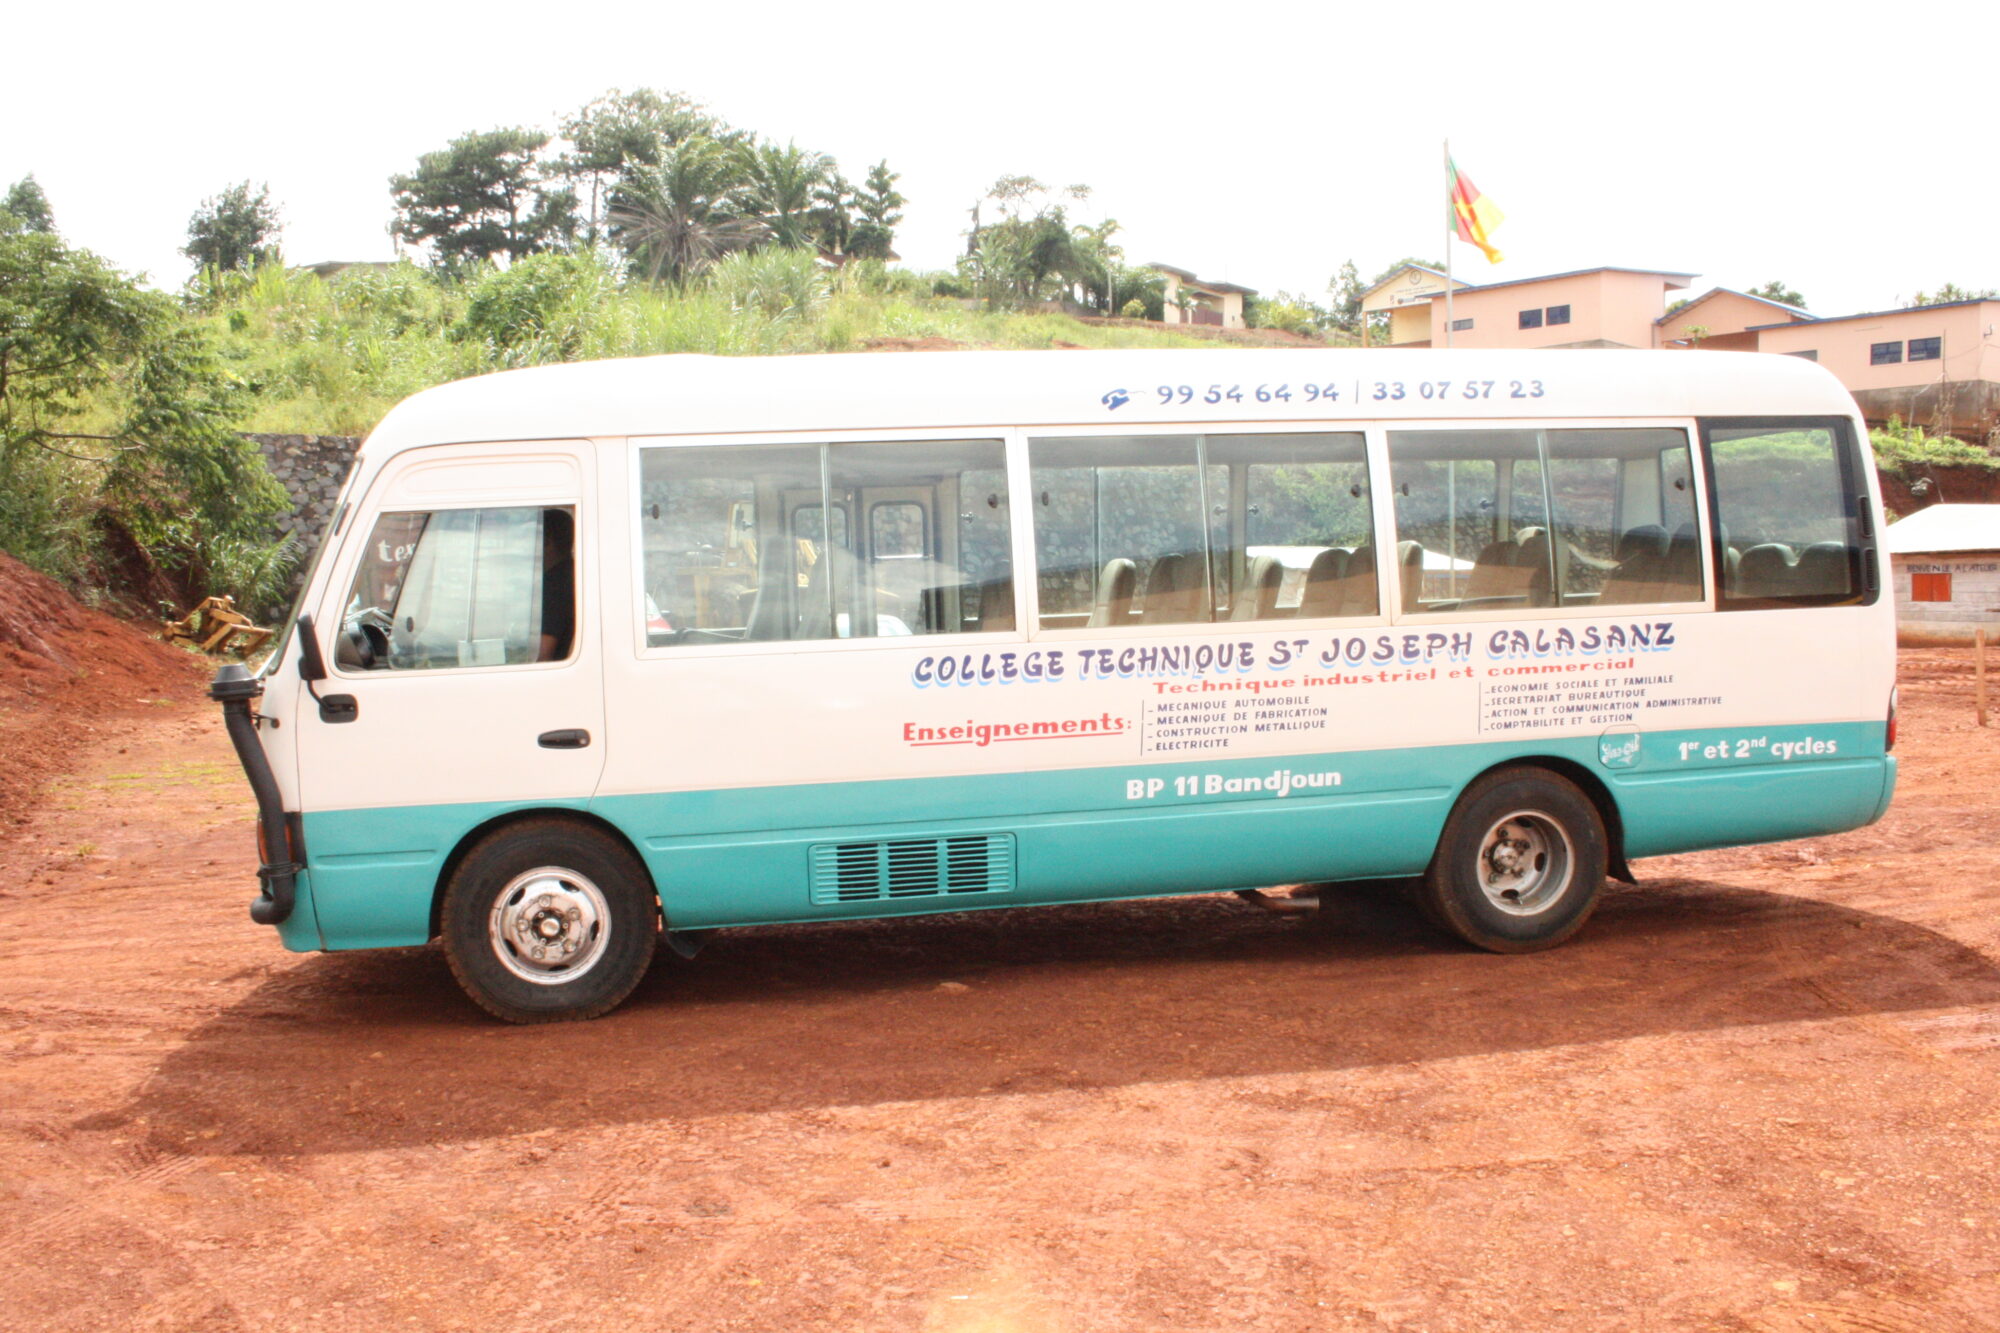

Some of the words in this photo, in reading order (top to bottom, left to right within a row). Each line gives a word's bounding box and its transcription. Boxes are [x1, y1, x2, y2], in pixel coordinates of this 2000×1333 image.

[1157, 385, 1194, 405] 99
[1204, 384, 1244, 404] 54
[1255, 384, 1292, 403] 64
[1304, 382, 1339, 402] 94
[1373, 382, 1406, 401] 33
[1419, 381, 1451, 400] 07
[1462, 380, 1495, 399] 57
[1510, 380, 1545, 399] 23
[913, 650, 1066, 688] COLLEGE
[1078, 642, 1255, 680] TECHNIQUE
[1319, 632, 1473, 668] JOSEPH
[1486, 623, 1676, 659] CALASANZ
[1153, 678, 1296, 695] Technique
[1303, 668, 1436, 687] industriel
[1449, 666, 1475, 679] et
[1487, 658, 1635, 677] commercial
[1491, 683, 1549, 694] ECONOMIE
[1556, 680, 1600, 690] SOCIALE
[1605, 678, 1618, 688] ET
[1624, 675, 1674, 686] FAMILIALE
[1157, 700, 1228, 712] MECANIQUE
[1234, 696, 1311, 708] AUTOMOBILE
[1491, 694, 1562, 706] SECRETARIAT
[1569, 689, 1646, 702] BUREAUTIQUE
[1491, 708, 1528, 718] ACTION
[1534, 707, 1545, 716] ET
[1552, 701, 1640, 714] COMMUNICATION
[1646, 696, 1723, 709] ADMINISTRATIVE
[1157, 713, 1227, 726] MECANIQUE
[1233, 712, 1248, 721] DE
[1255, 707, 1328, 720] FABRICATION
[1490, 718, 1565, 731] COMPTABILITE
[1571, 717, 1583, 725] ET
[1590, 713, 1633, 724] GESTION
[1156, 725, 1248, 738] CONSTRUCTION
[1254, 720, 1327, 733] METALLIQUE
[1155, 738, 1230, 751] ELECTRICITE
[1678, 741, 1700, 760] 1er
[1703, 740, 1729, 759] et
[1734, 736, 1767, 759] 2nd
[1771, 737, 1838, 761] cycles
[1126, 779, 1165, 800] BP
[1174, 776, 1199, 796] 11
[1204, 769, 1342, 798] Bandjoun
